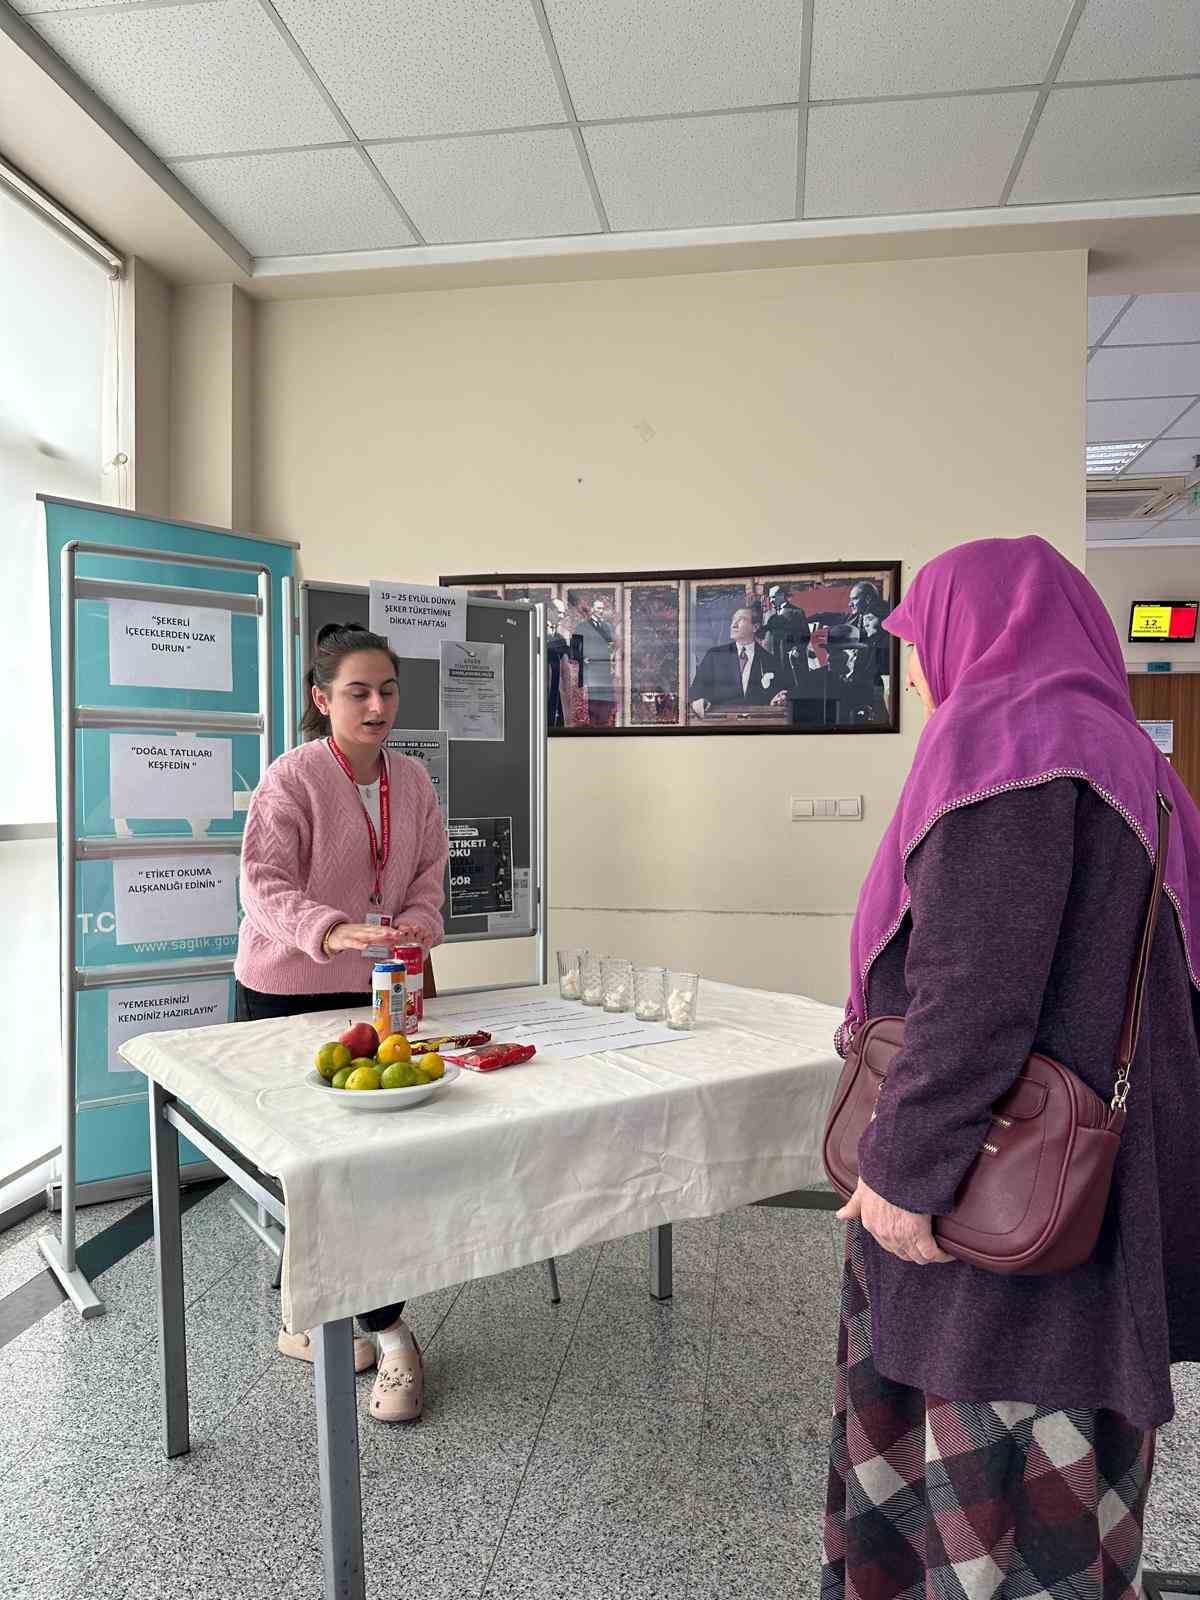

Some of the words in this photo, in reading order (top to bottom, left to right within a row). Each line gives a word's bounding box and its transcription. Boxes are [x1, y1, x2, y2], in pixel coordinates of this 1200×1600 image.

[381, 592, 390, 600] 19
[398, 593, 407, 601] 25
[408, 593, 430, 604] EYLÜL
[431, 596, 456, 605] DÜNYA
[385, 604, 407, 613] ŞEKER
[409, 605, 452, 617] TÜKETİMİNE
[389, 616, 416, 625] DİKKAT
[417, 619, 447, 628] HAFTASI
[125, 626, 189, 640] İÇECEKLERDEN
[192, 632, 216, 642] UZAK
[151, 642, 185, 653] DURUN
[170, 748, 213, 758] TATLILARI
[148, 760, 190, 771] KEŞFEDİN
[448, 848, 471, 857] OKU
[145, 867, 175, 879] ETİKET
[177, 867, 212, 877] OKUMA
[128, 879, 184, 894] ALIŞKANLIĞI
[185, 879, 216, 890] EDİNİN
[118, 1011, 161, 1023] KENDİNİZ
